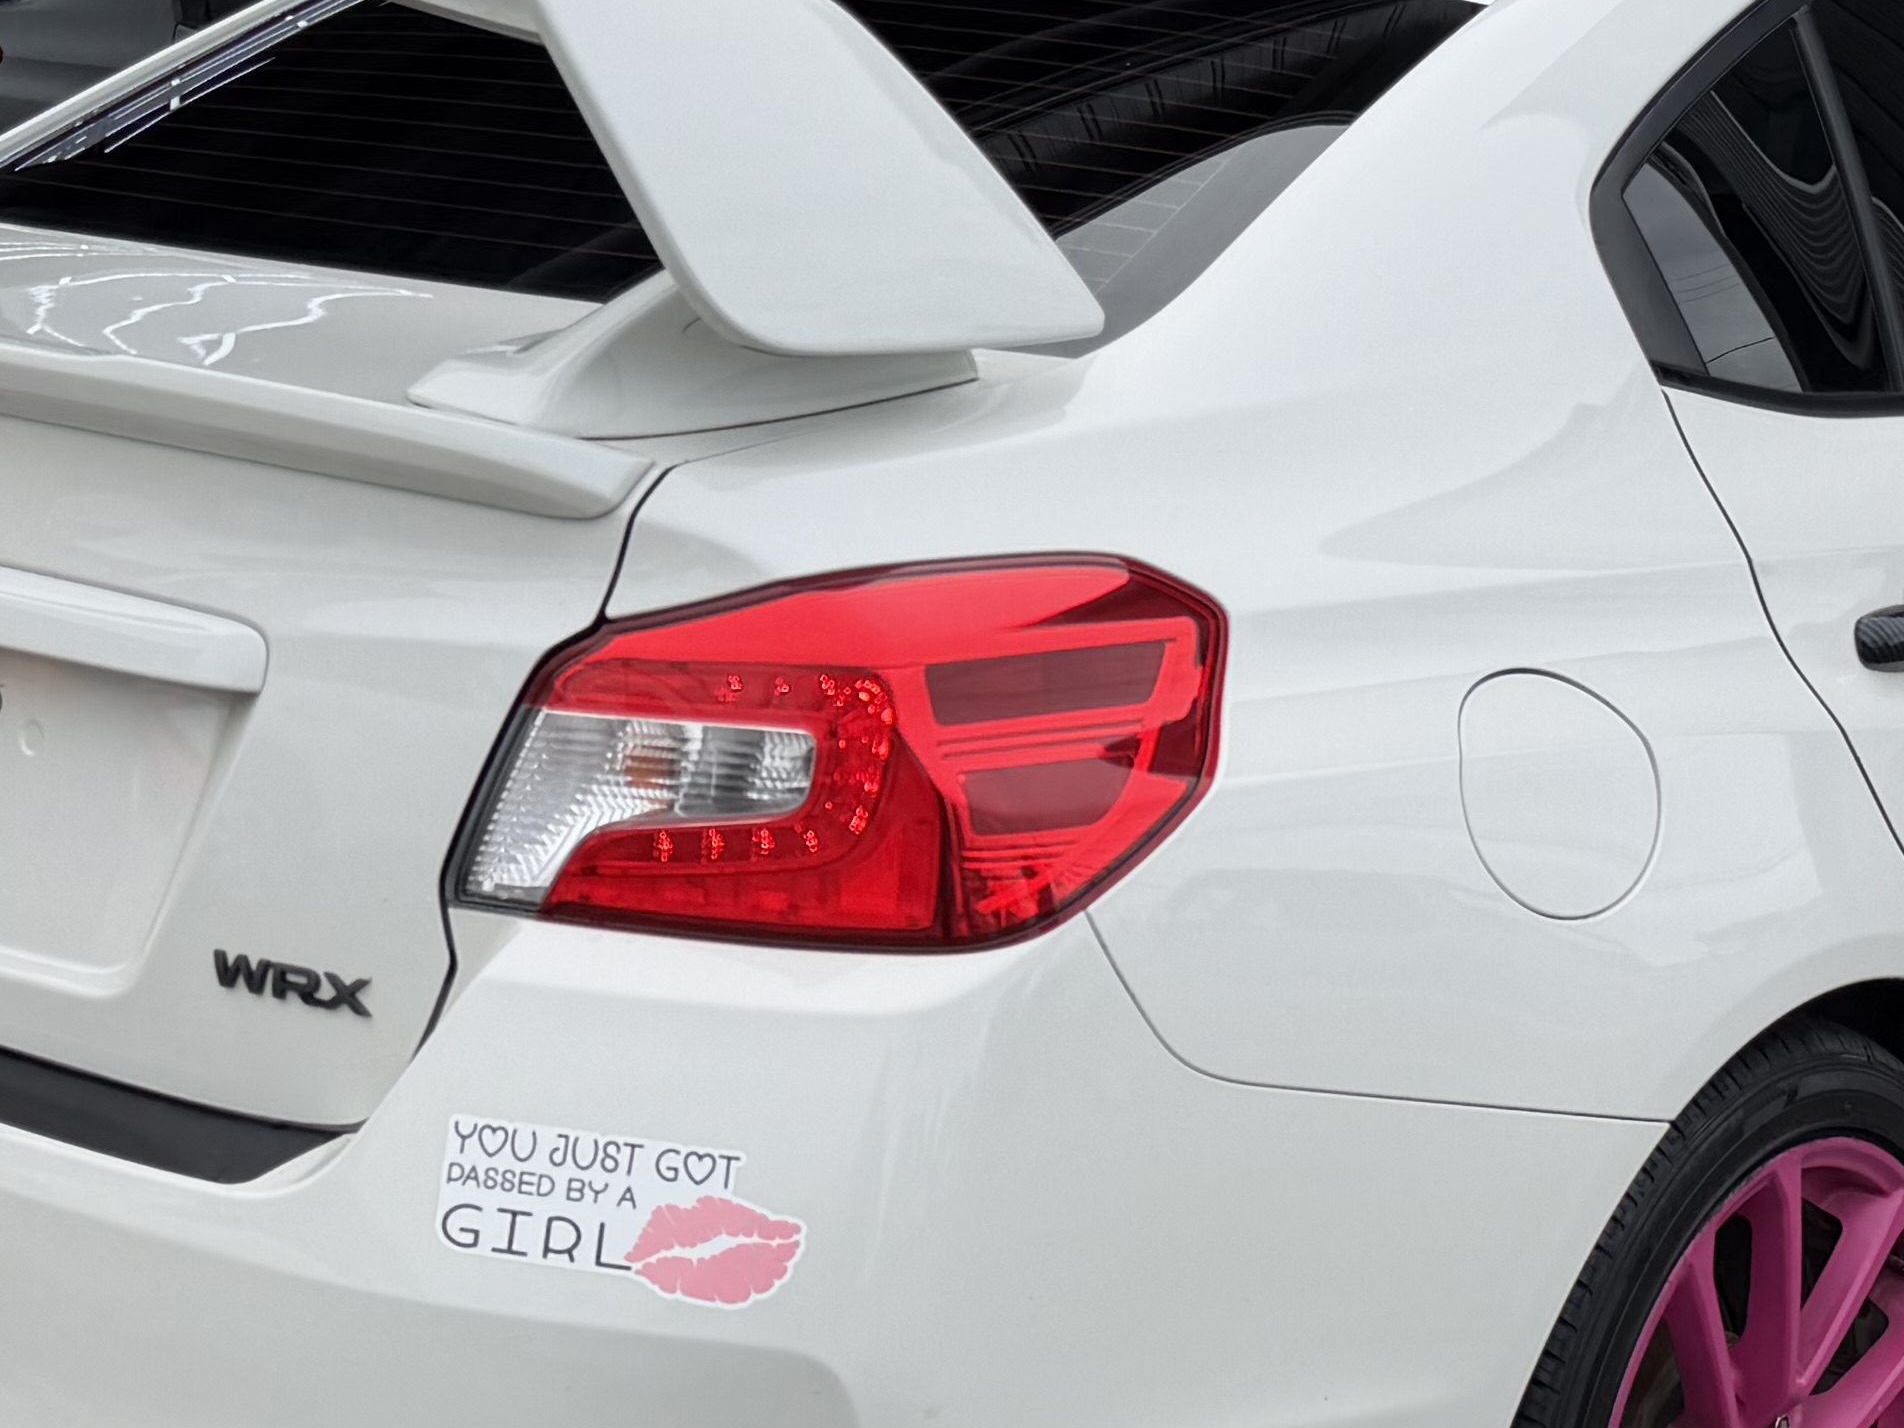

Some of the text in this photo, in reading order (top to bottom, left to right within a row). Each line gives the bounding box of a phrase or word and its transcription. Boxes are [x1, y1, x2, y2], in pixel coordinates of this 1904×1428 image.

[213, 948, 372, 1018] WRX
[446, 1161, 637, 1210] PASSED BY A
[454, 1120, 741, 1189] YOU JUST GOT
[441, 1203, 632, 1271] GIRL
